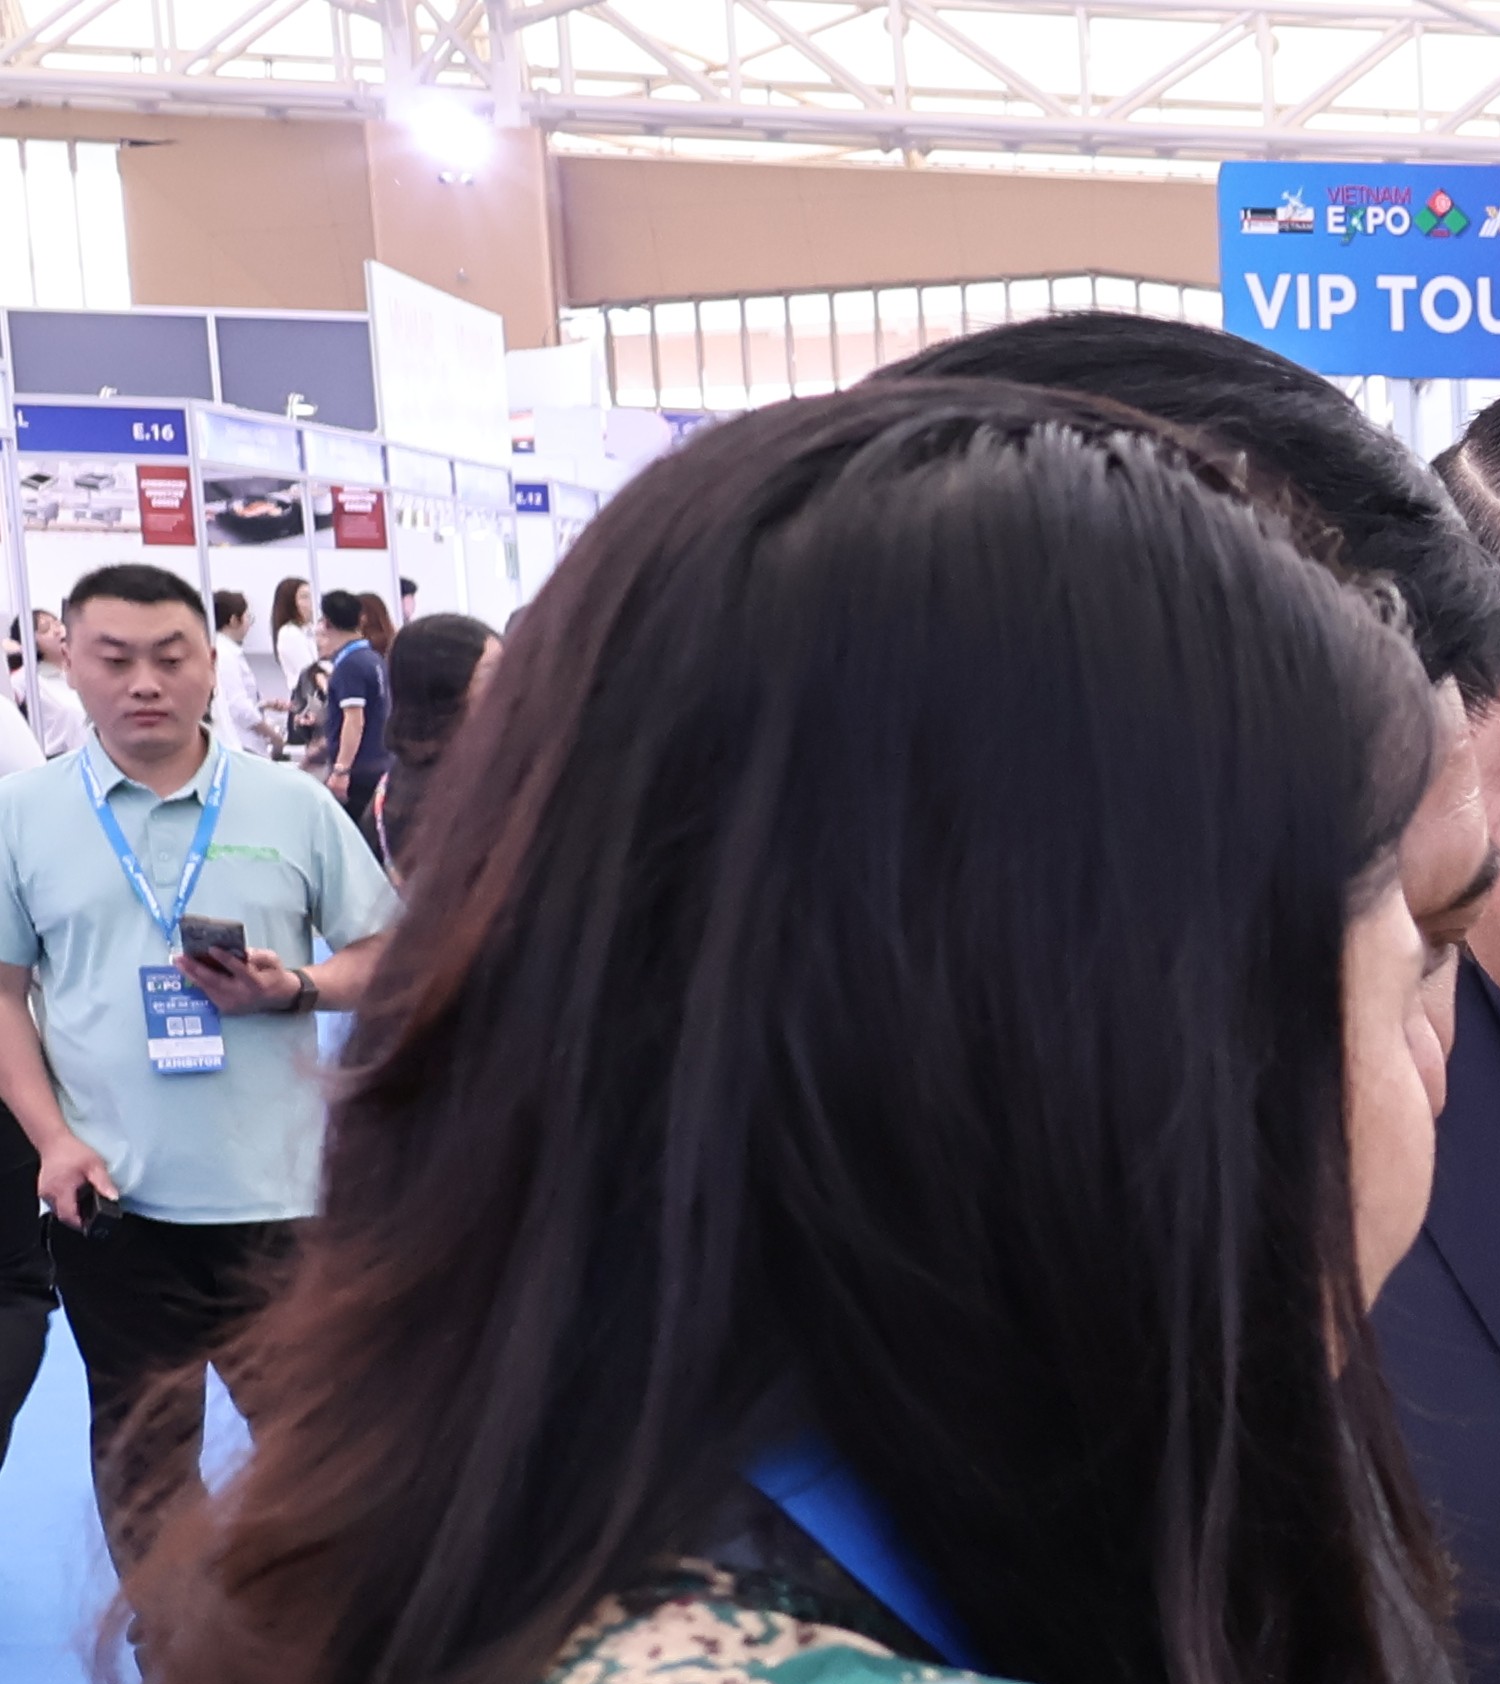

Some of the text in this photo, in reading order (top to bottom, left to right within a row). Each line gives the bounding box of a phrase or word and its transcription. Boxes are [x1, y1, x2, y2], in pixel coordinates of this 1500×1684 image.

[1327, 186, 1412, 205] VIETNAM
[1327, 205, 1411, 242] EXPO
[1243, 272, 1357, 331] VIP
[132, 421, 175, 442] E.16
